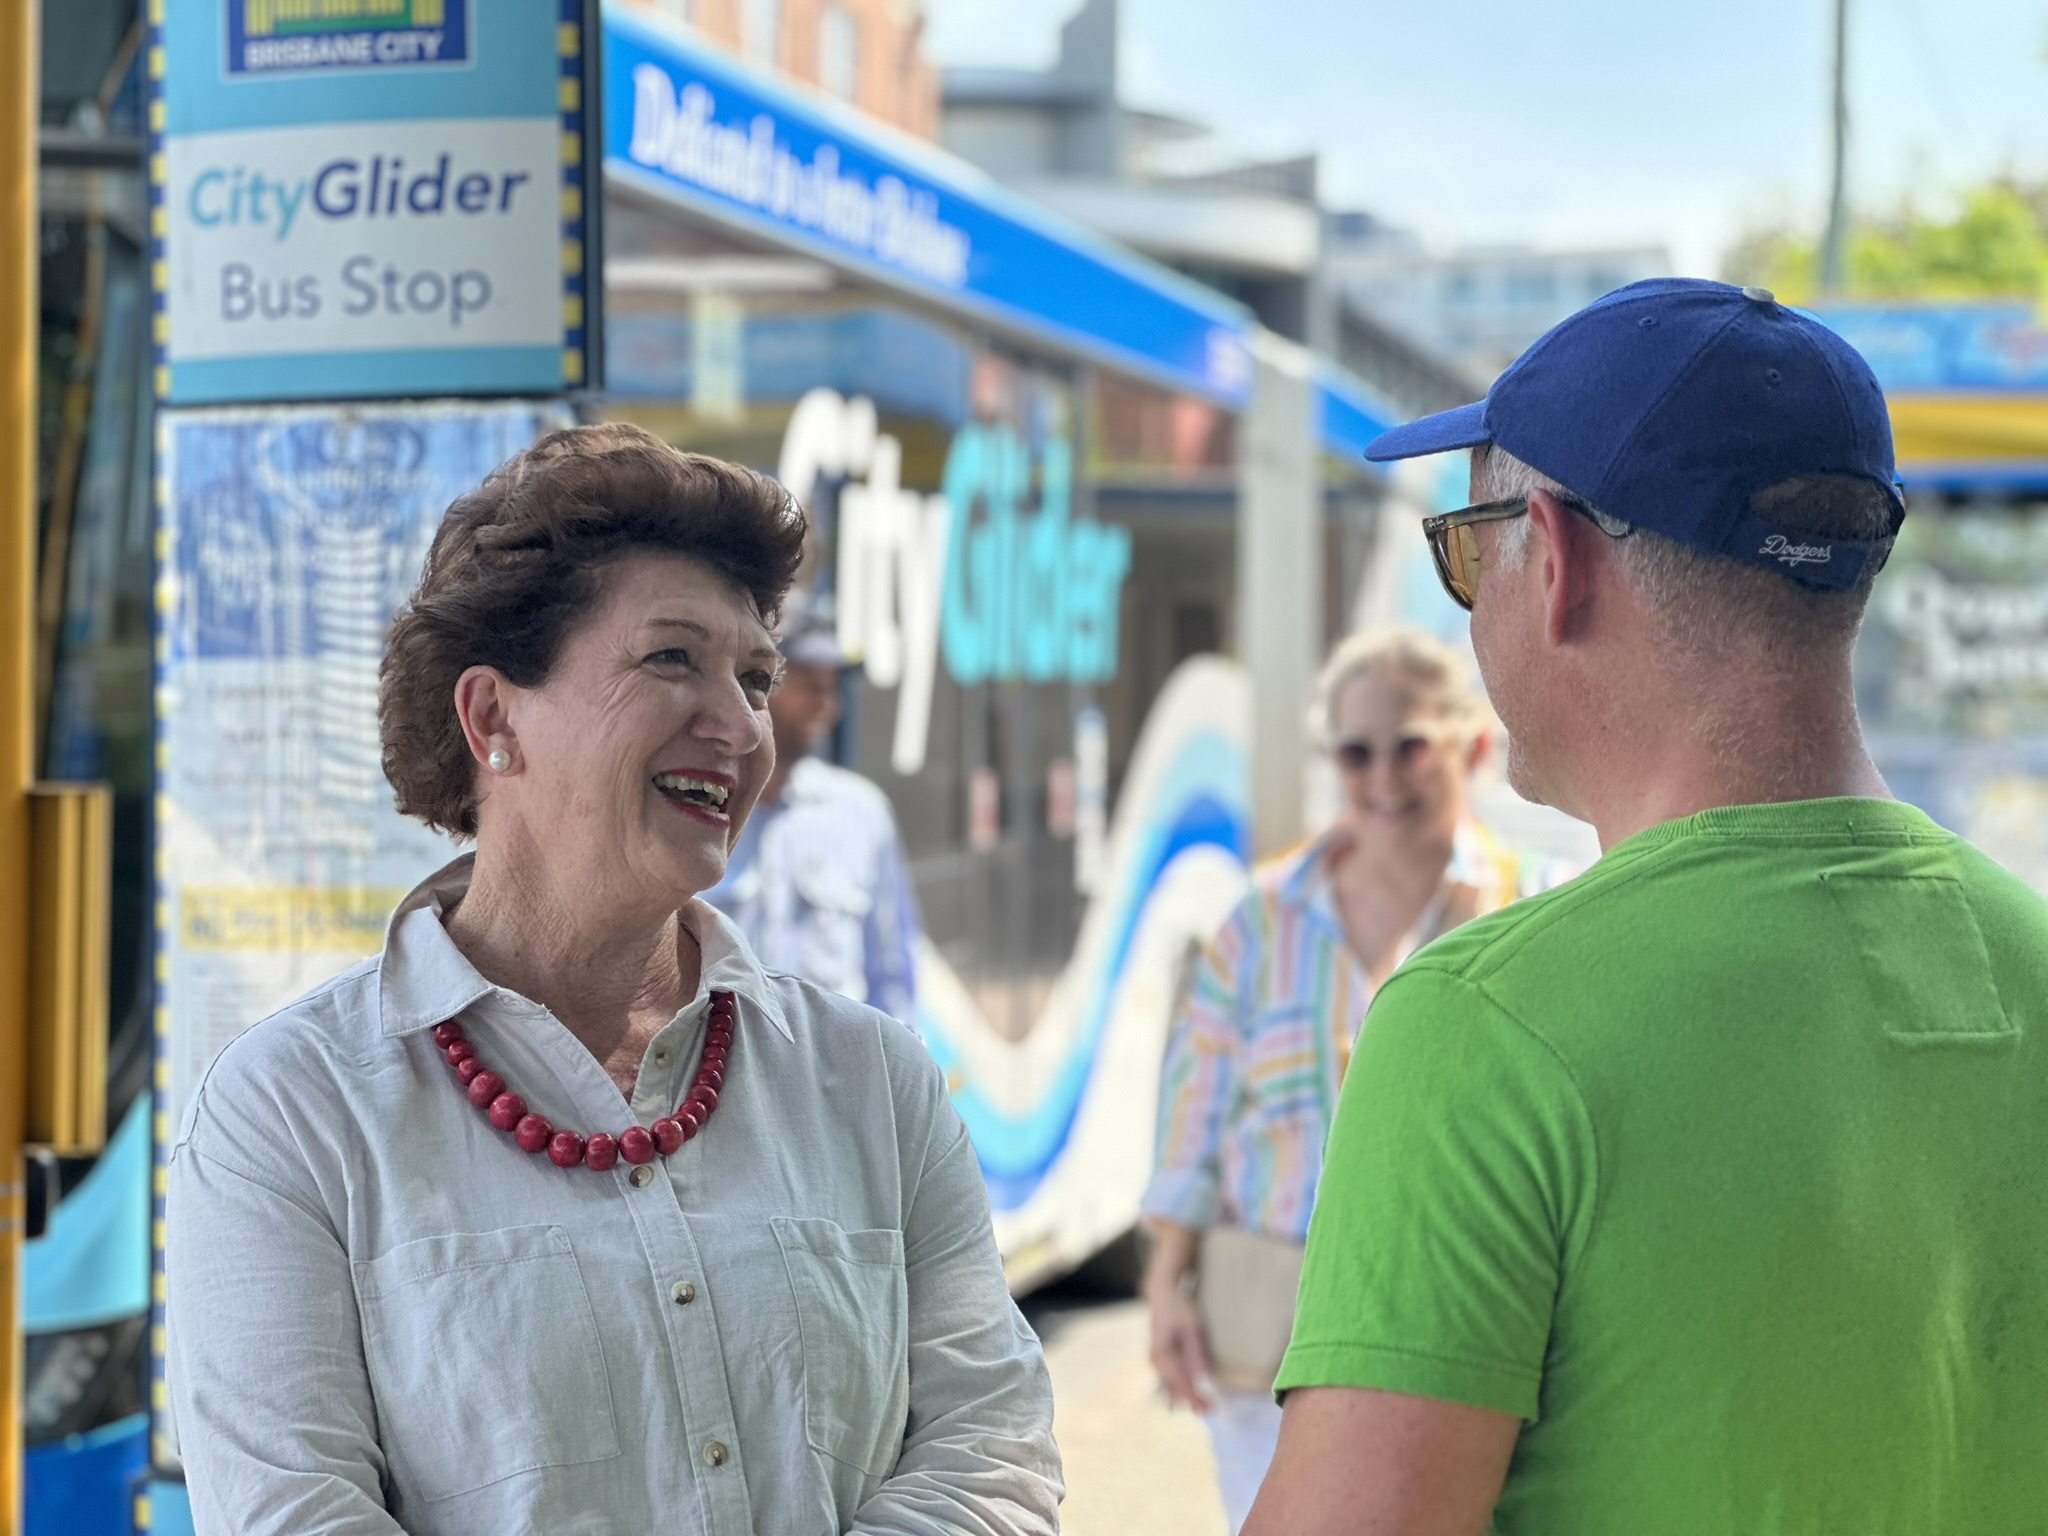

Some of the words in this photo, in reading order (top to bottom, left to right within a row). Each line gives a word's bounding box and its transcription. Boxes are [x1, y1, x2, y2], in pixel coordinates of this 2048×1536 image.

[244, 33, 373, 69] BRISBANE
[375, 29, 445, 63] CITY
[220, 262, 323, 322] Bus
[341, 254, 494, 328] Stop
[1758, 534, 1832, 567] Dodgers
